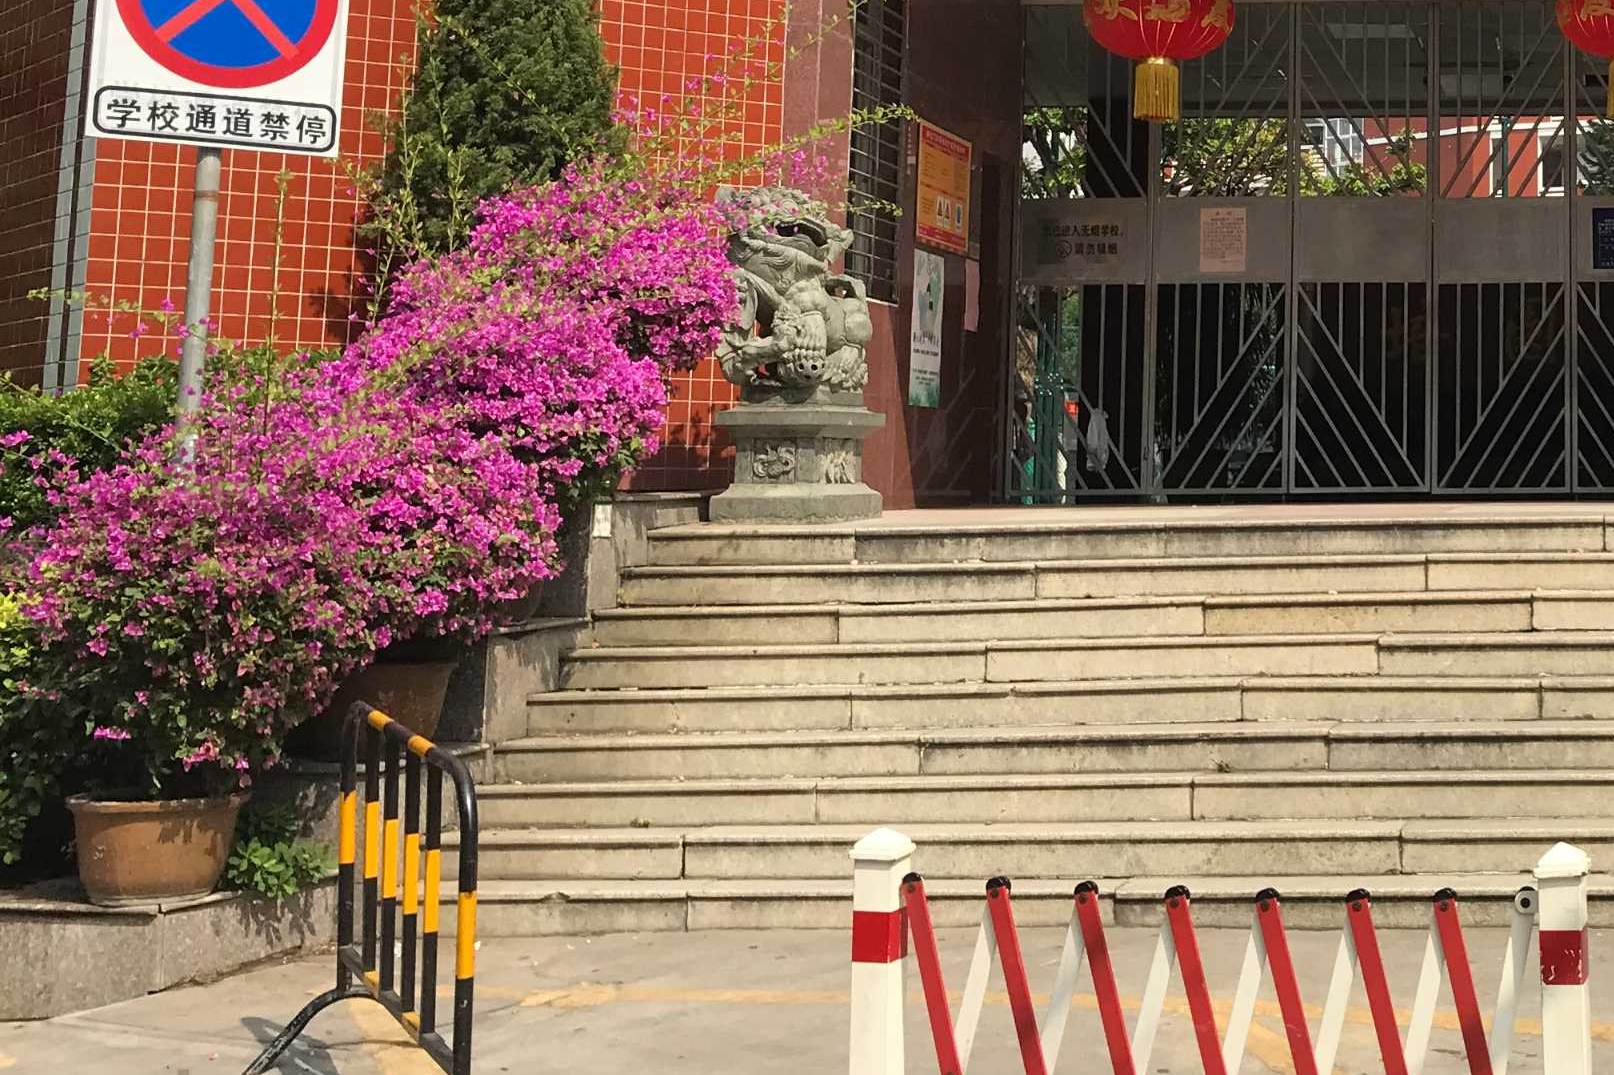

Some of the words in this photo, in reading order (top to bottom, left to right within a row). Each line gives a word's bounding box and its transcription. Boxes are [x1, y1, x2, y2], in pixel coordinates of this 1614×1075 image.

[106, 97, 327, 145] 学校通道禁停
